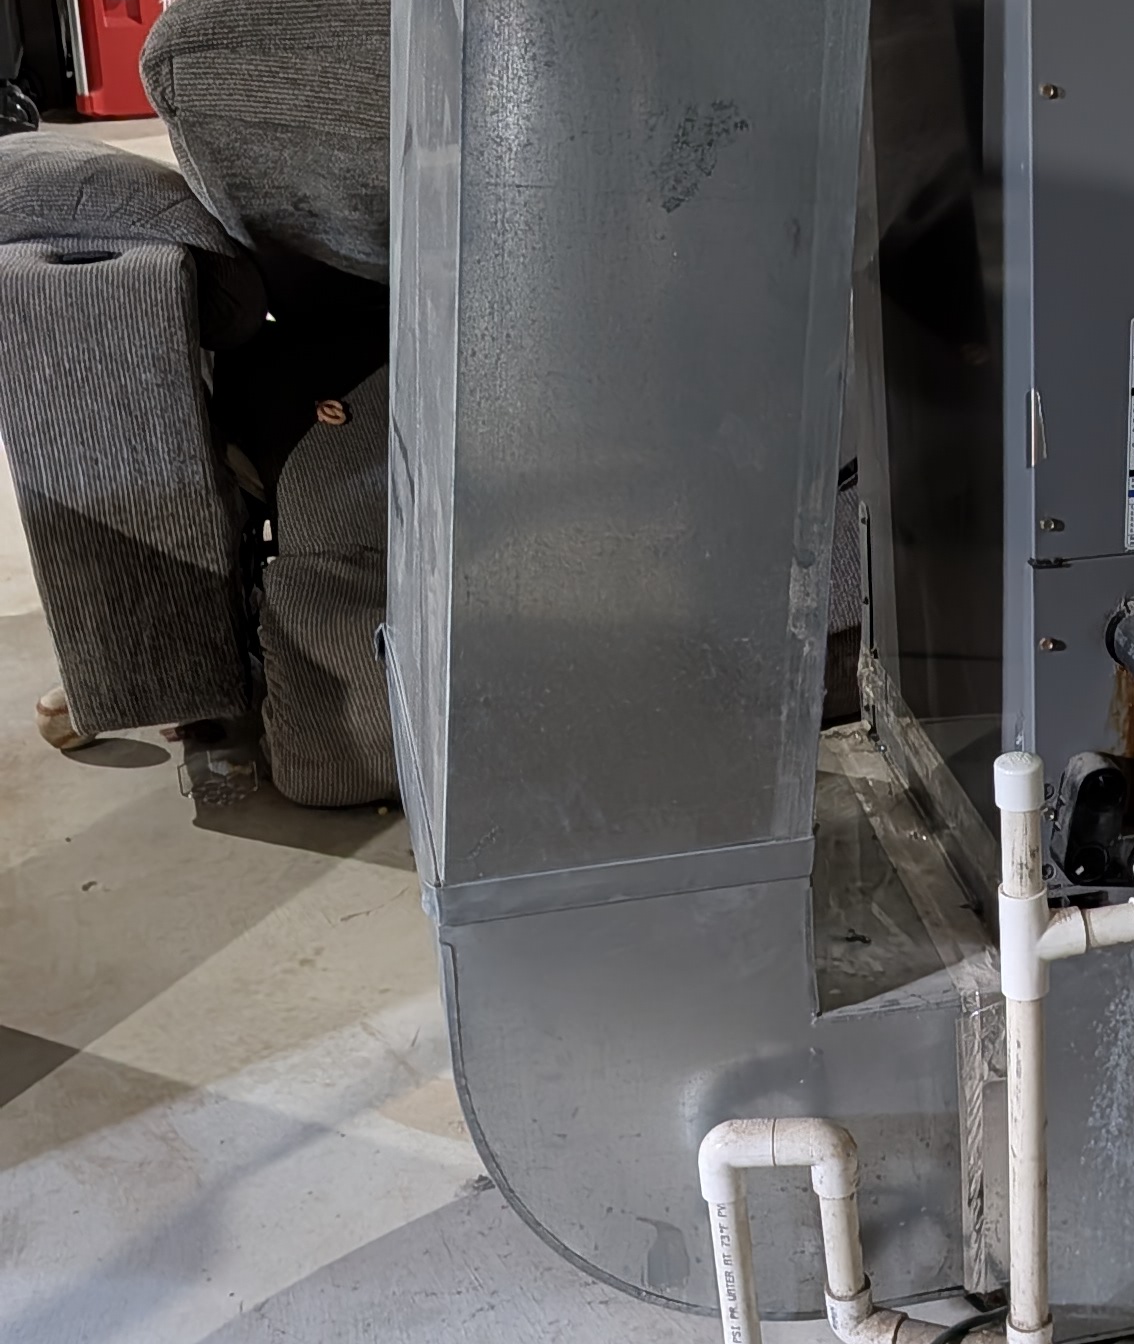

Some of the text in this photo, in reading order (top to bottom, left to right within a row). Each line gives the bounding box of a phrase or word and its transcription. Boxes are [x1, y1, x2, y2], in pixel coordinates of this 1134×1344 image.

[722, 1253, 732, 1266] AT
[729, 1305, 738, 1319] PR
[731, 1326, 742, 1343] PSI
